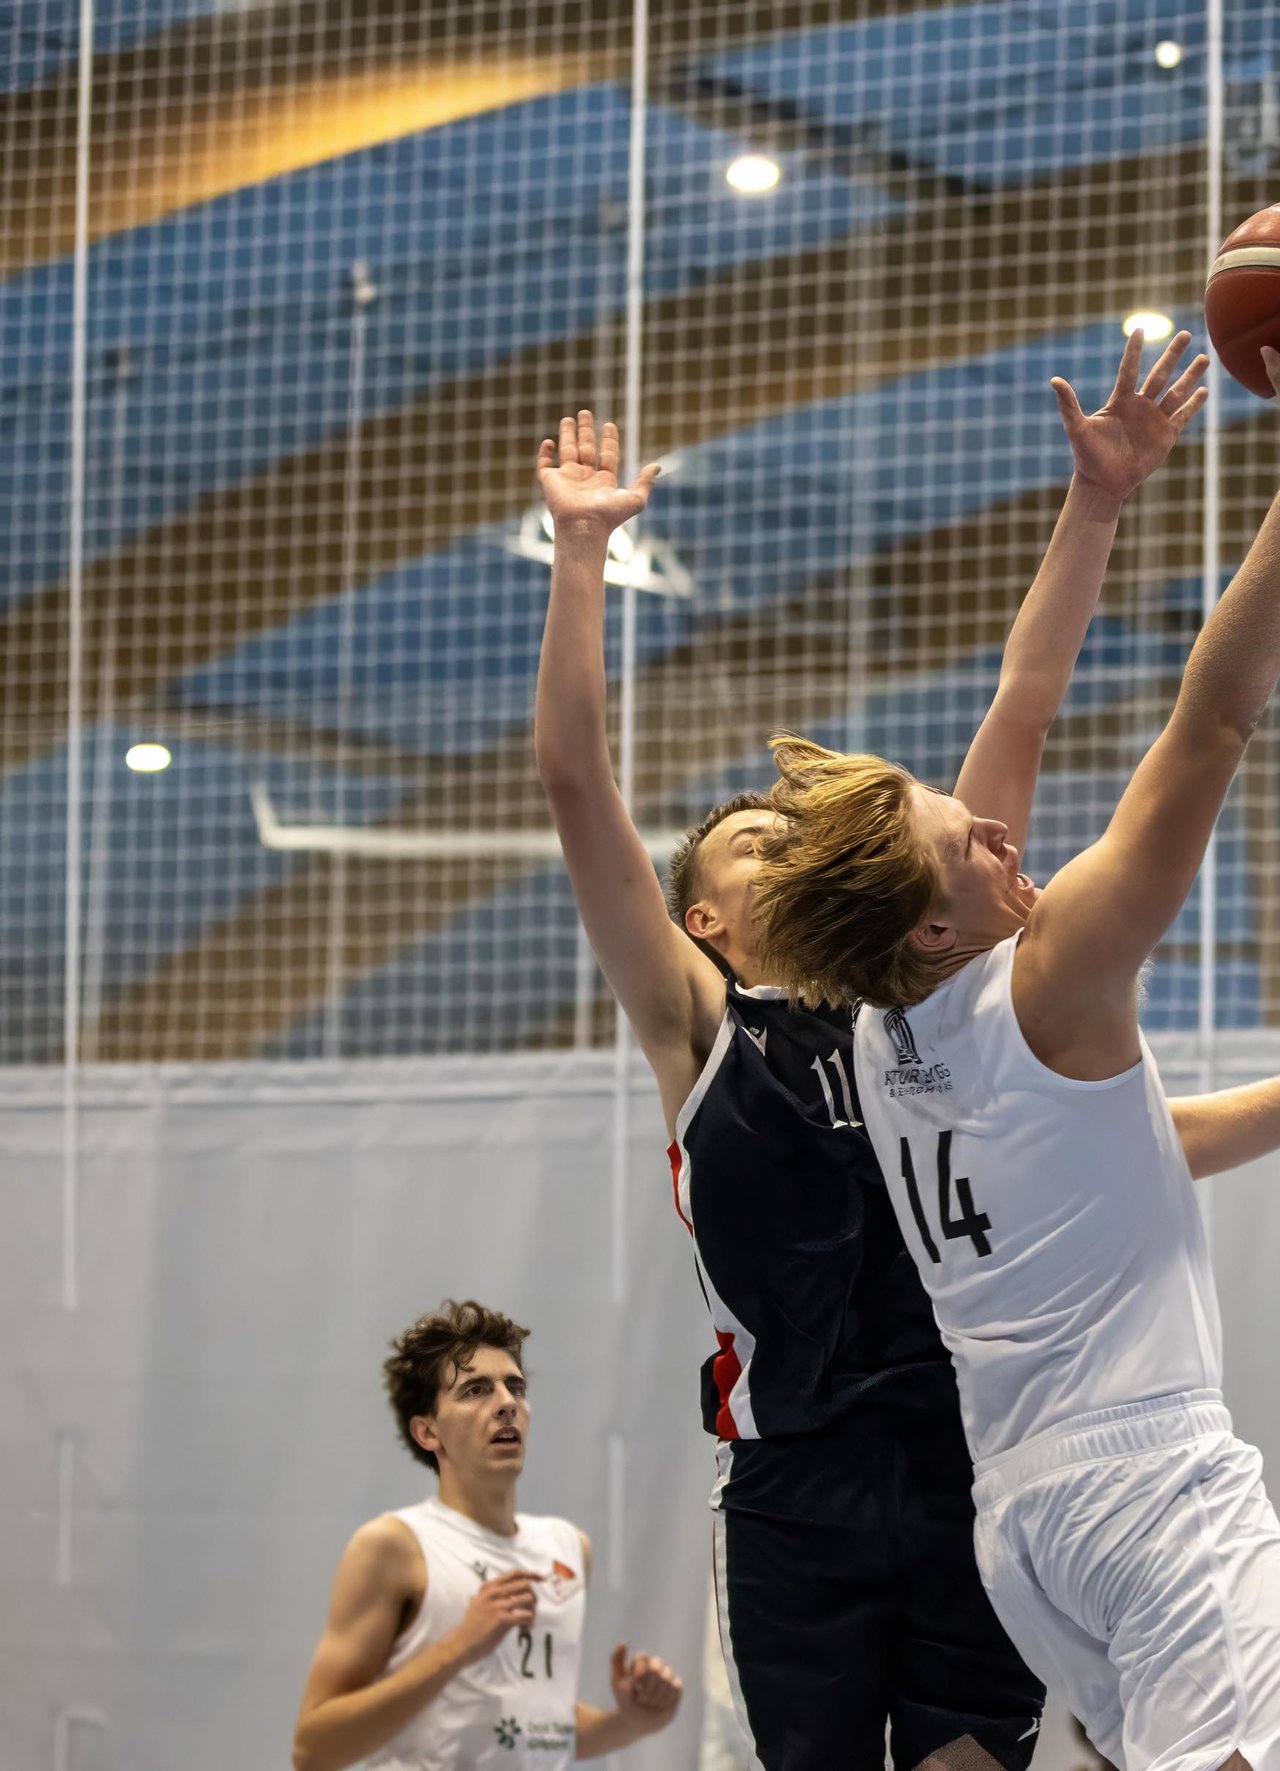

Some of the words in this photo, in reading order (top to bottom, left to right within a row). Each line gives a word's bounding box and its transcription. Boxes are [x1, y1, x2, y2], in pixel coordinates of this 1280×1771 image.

[810, 1048, 863, 1129] 11
[900, 1130, 992, 1263] 14
[518, 1631, 553, 1679] 21
